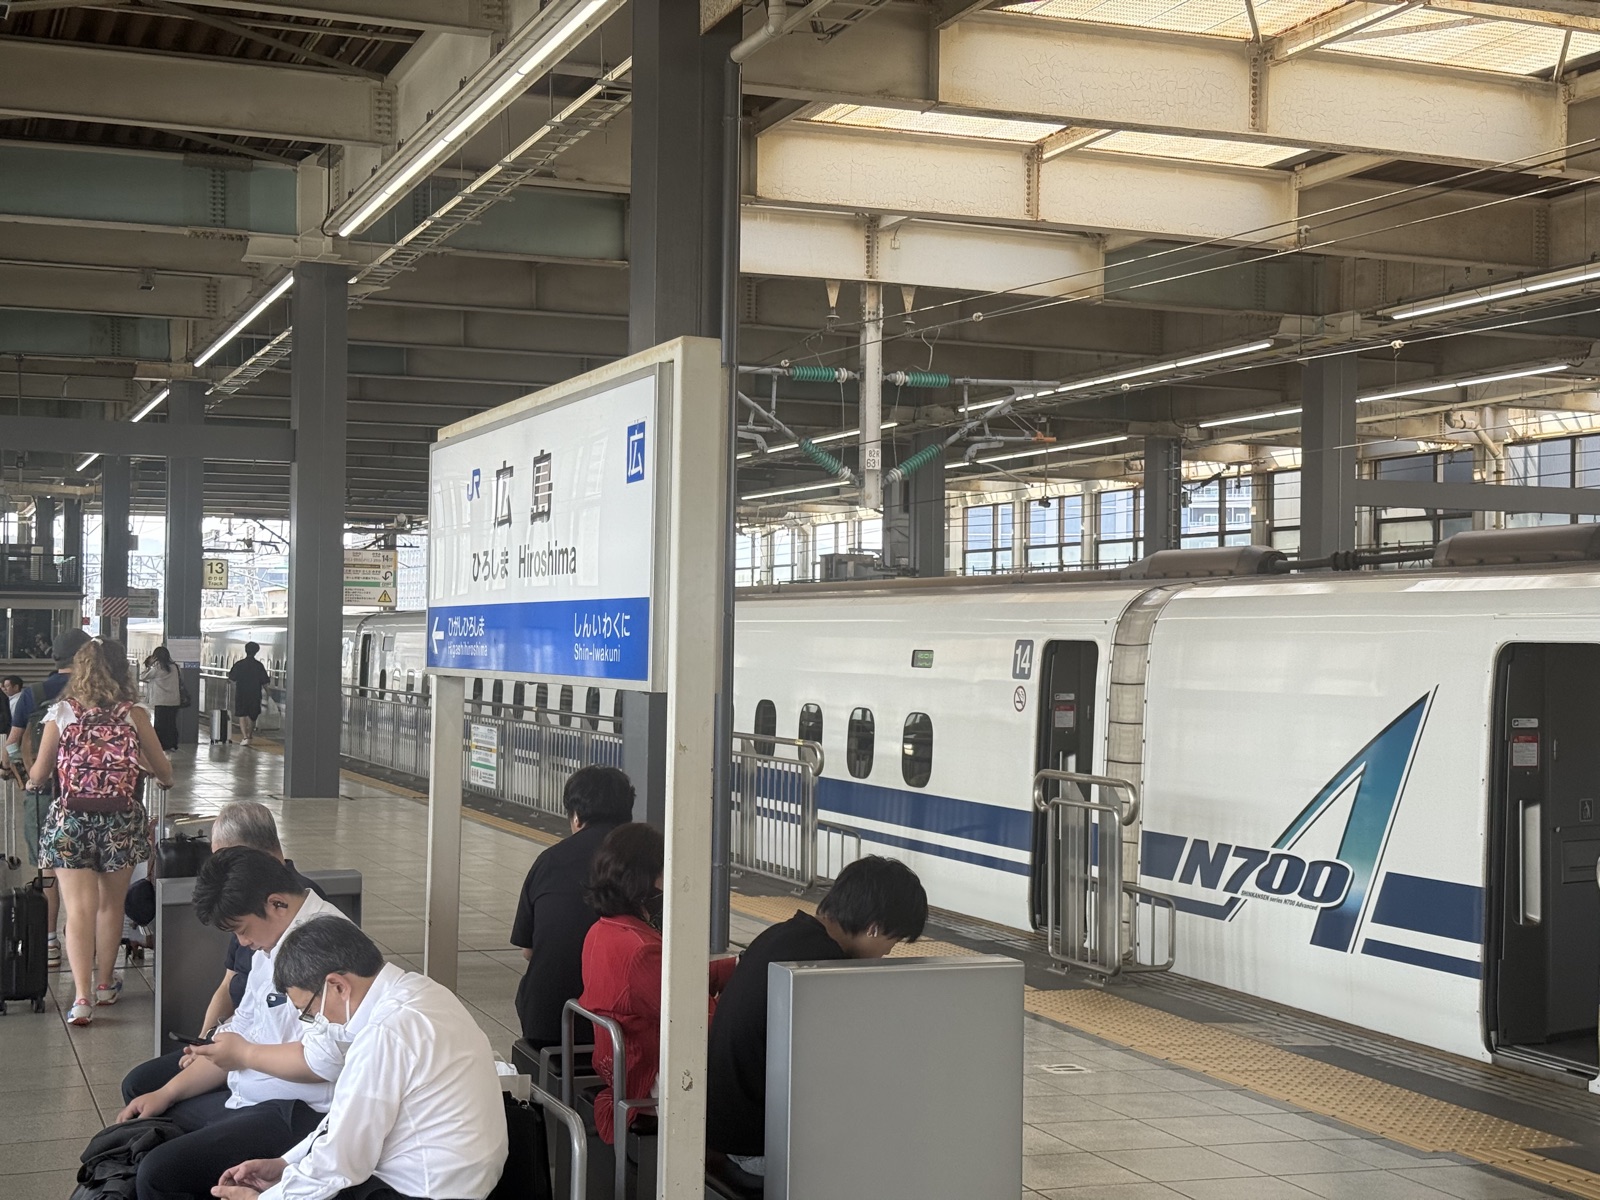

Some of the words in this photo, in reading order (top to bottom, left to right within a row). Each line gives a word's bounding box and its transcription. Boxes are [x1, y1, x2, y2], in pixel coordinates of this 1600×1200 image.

[628, 429, 644, 477] 広
[467, 468, 480, 502] JR
[493, 449, 553, 529] 広島
[207, 561, 225, 575] 13
[472, 547, 509, 582] ひろしま
[518, 540, 577, 579] Hiroshima
[448, 615, 485, 637] ひがしひろしま
[574, 612, 631, 639] しんいわくに
[574, 643, 621, 662] Shin-Iwakuni
[1015, 645, 1031, 675] 14
[1178, 838, 1354, 909] N700
[1241, 890, 1270, 901] SHINKANSEN
[1269, 896, 1283, 904] series
[1283, 898, 1296, 907] N700
[1295, 901, 1319, 911] Advanced
